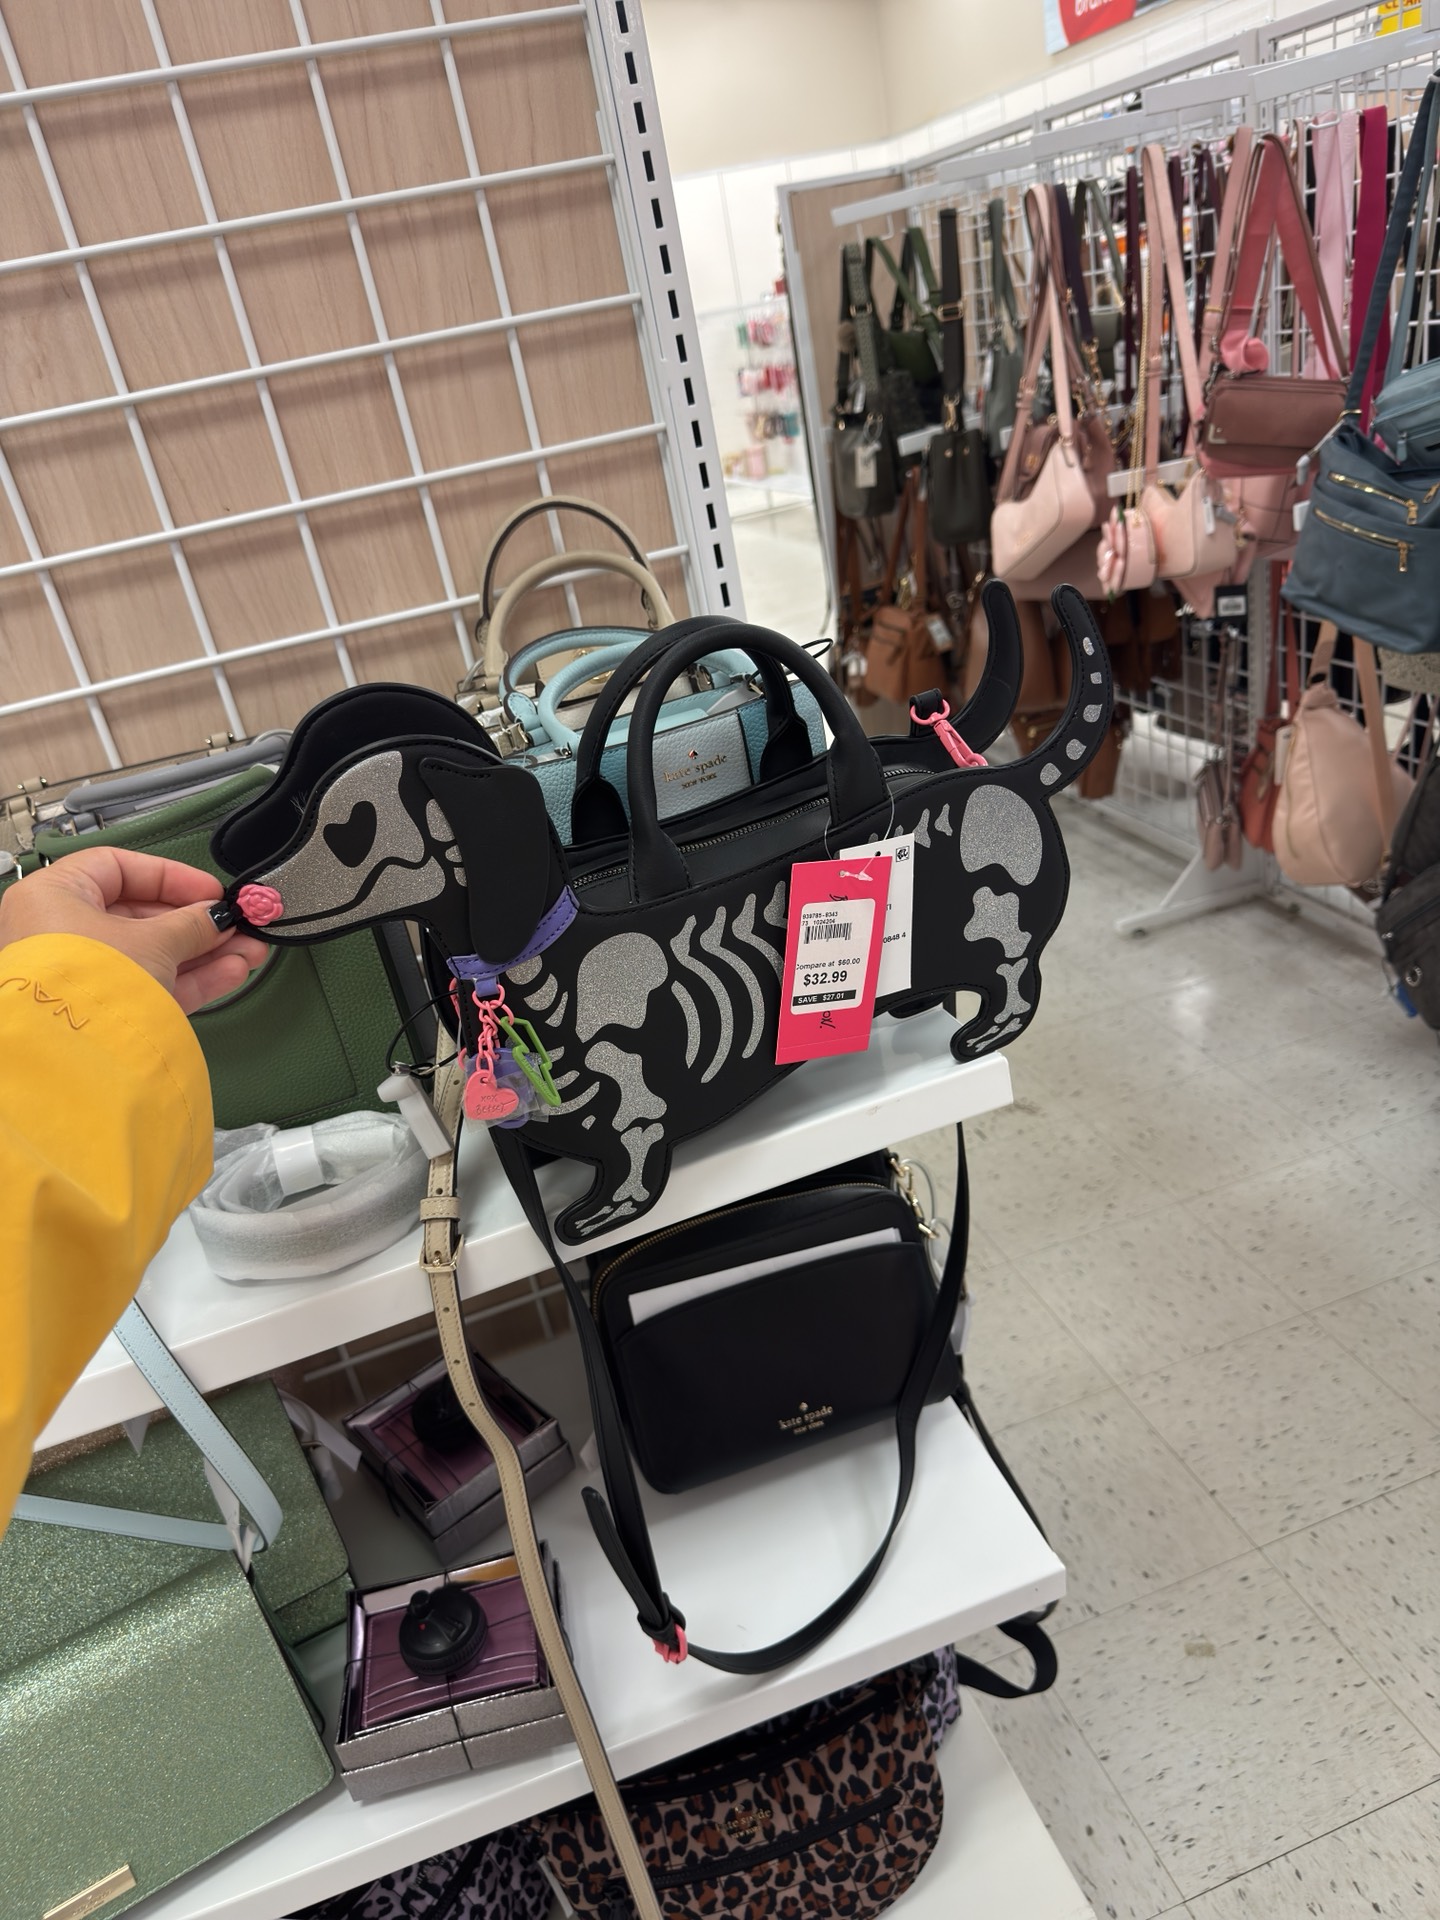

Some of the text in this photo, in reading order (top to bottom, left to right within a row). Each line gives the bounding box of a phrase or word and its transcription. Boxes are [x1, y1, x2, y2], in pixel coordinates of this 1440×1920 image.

[695, 753, 727, 774] spade
[803, 970, 848, 987] $32.99
[797, 992, 844, 1004] SAVE $27.01
[779, 1406, 833, 1430] kate spade
